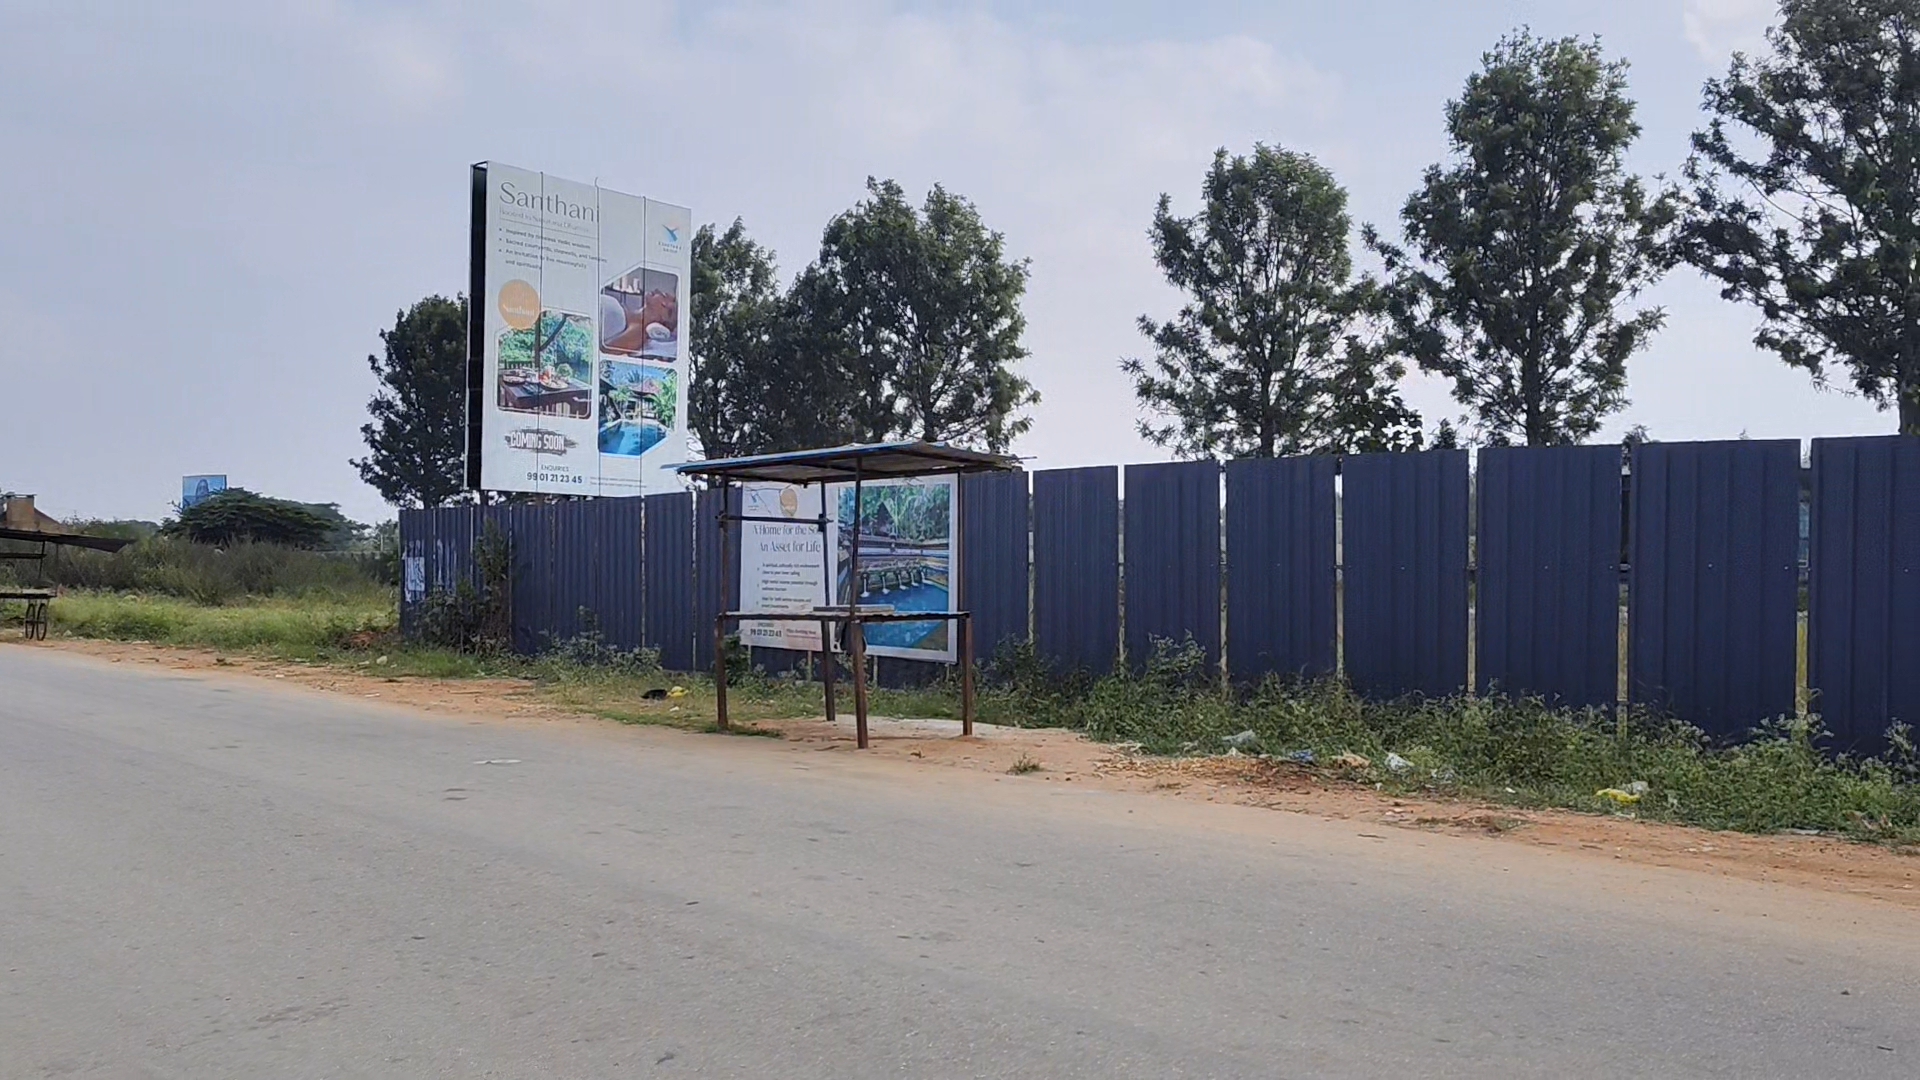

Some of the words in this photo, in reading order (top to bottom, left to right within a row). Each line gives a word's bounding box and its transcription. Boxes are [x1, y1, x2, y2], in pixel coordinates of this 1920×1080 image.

[499, 181, 600, 223] Santhani
[510, 431, 542, 450] COMING
[542, 434, 567, 452] SOON
[541, 464, 570, 473] ENQUIRIES
[540, 473, 549, 482] 01
[550, 474, 559, 483] 21
[560, 474, 570, 484] 23
[571, 475, 583, 485] 45
[759, 524, 782, 536] Home
[783, 524, 794, 535] for
[795, 525, 807, 536] the
[769, 540, 791, 553] Asset
[792, 540, 805, 552] for
[805, 541, 821, 553] Life
